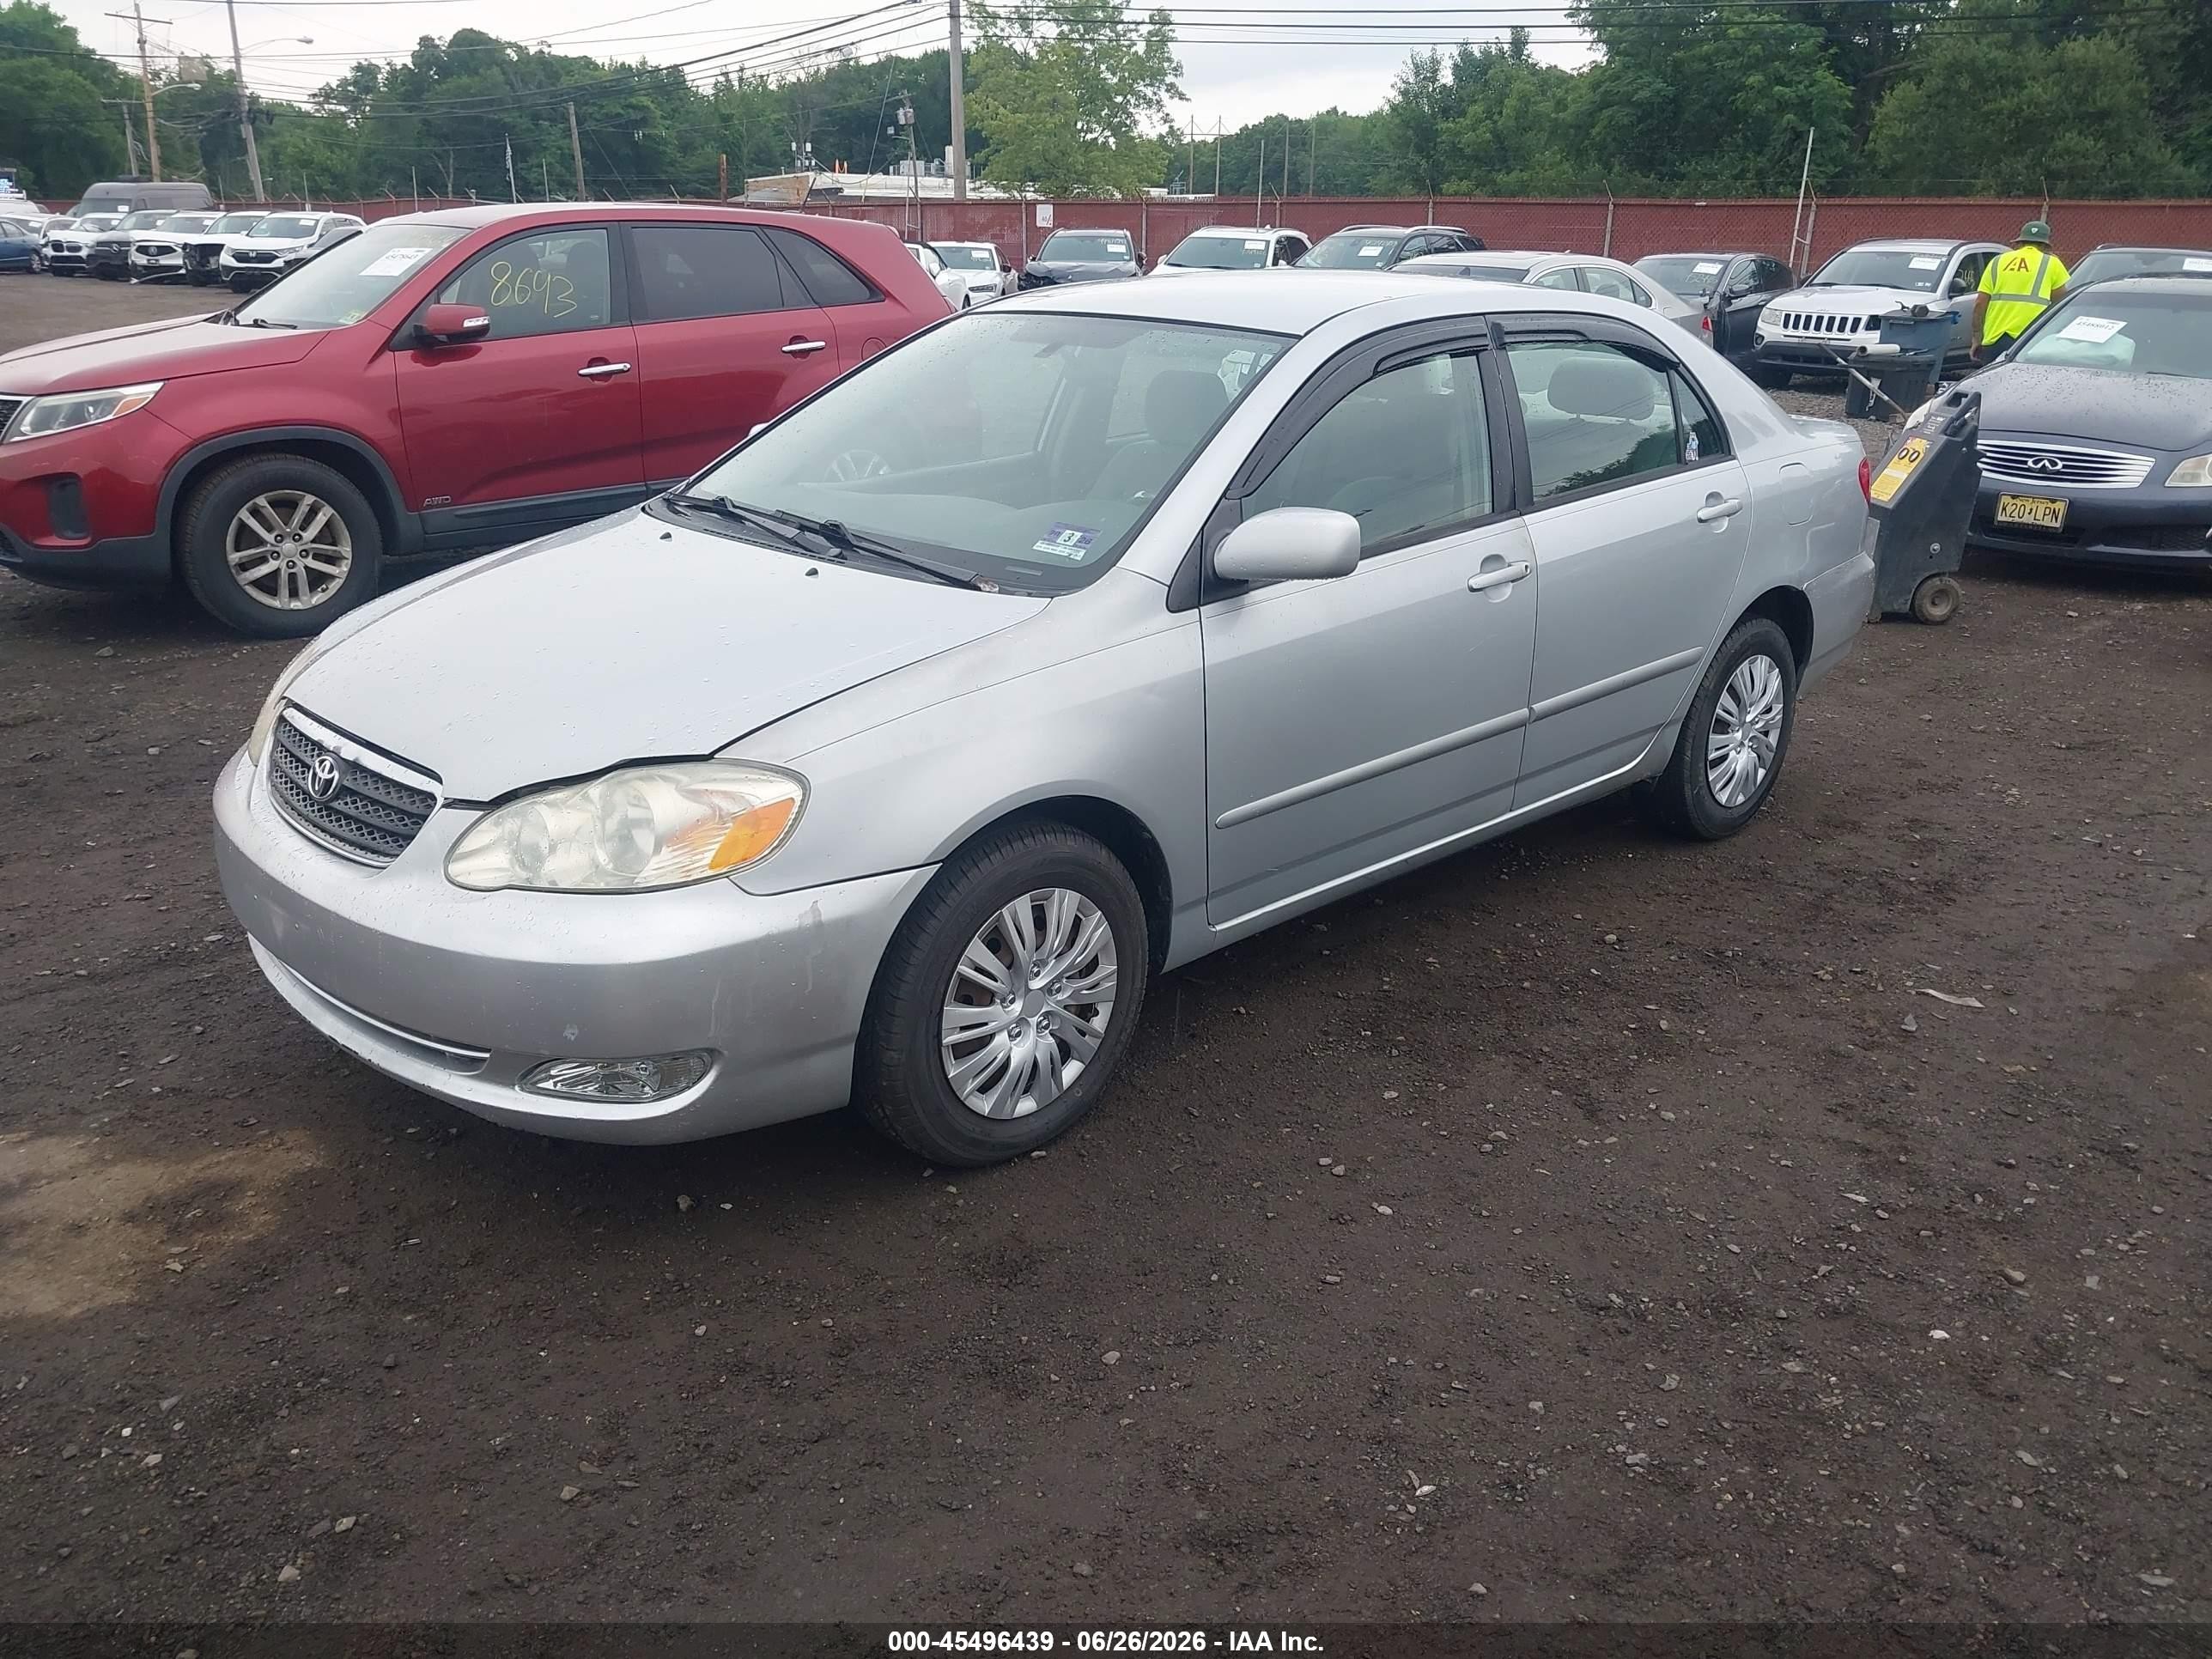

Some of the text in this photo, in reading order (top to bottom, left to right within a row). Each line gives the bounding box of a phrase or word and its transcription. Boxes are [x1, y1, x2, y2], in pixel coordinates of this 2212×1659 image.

[490, 261, 577, 318] 8693
[1999, 501, 2061, 524] K20 LPN
[1063, 532, 1075, 543] 3
